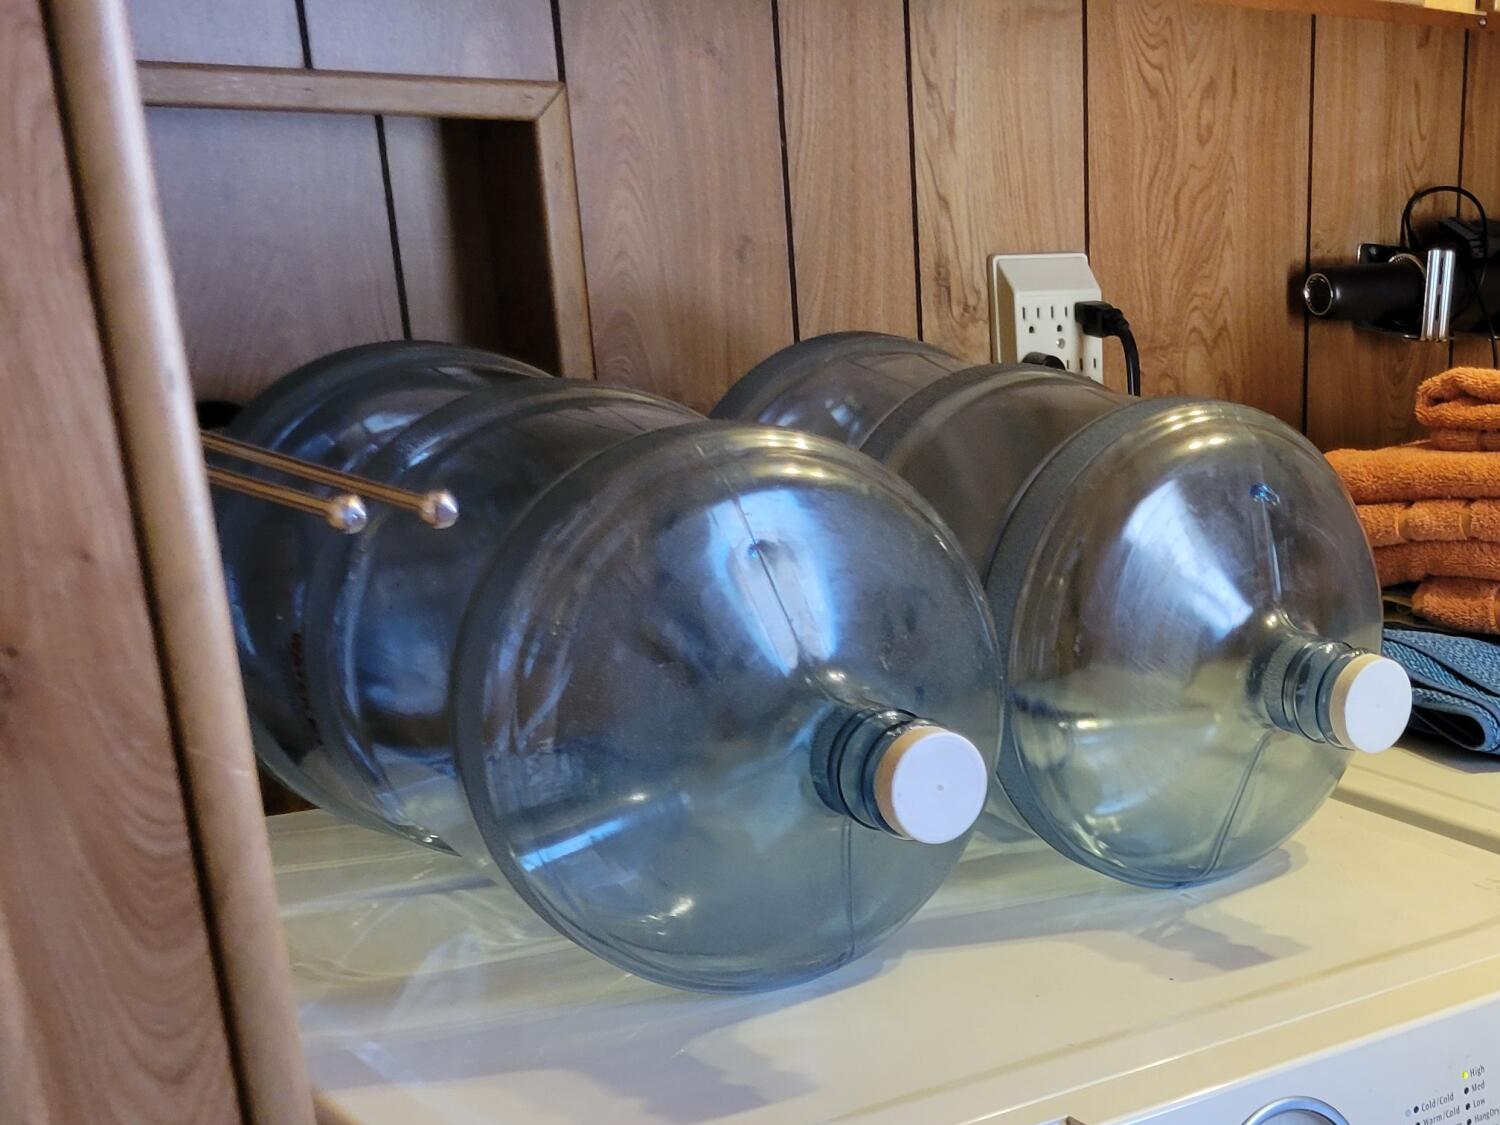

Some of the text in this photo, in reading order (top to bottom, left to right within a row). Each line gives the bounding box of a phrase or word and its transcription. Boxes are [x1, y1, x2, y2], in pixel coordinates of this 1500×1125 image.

[1469, 1065, 1485, 1078] High
[1471, 1080, 1485, 1092] Med
[1421, 1092, 1454, 1112] Cold/Cold
[1473, 1098, 1486, 1108] Low
[1474, 1108, 1500, 1123] Hang Dry
